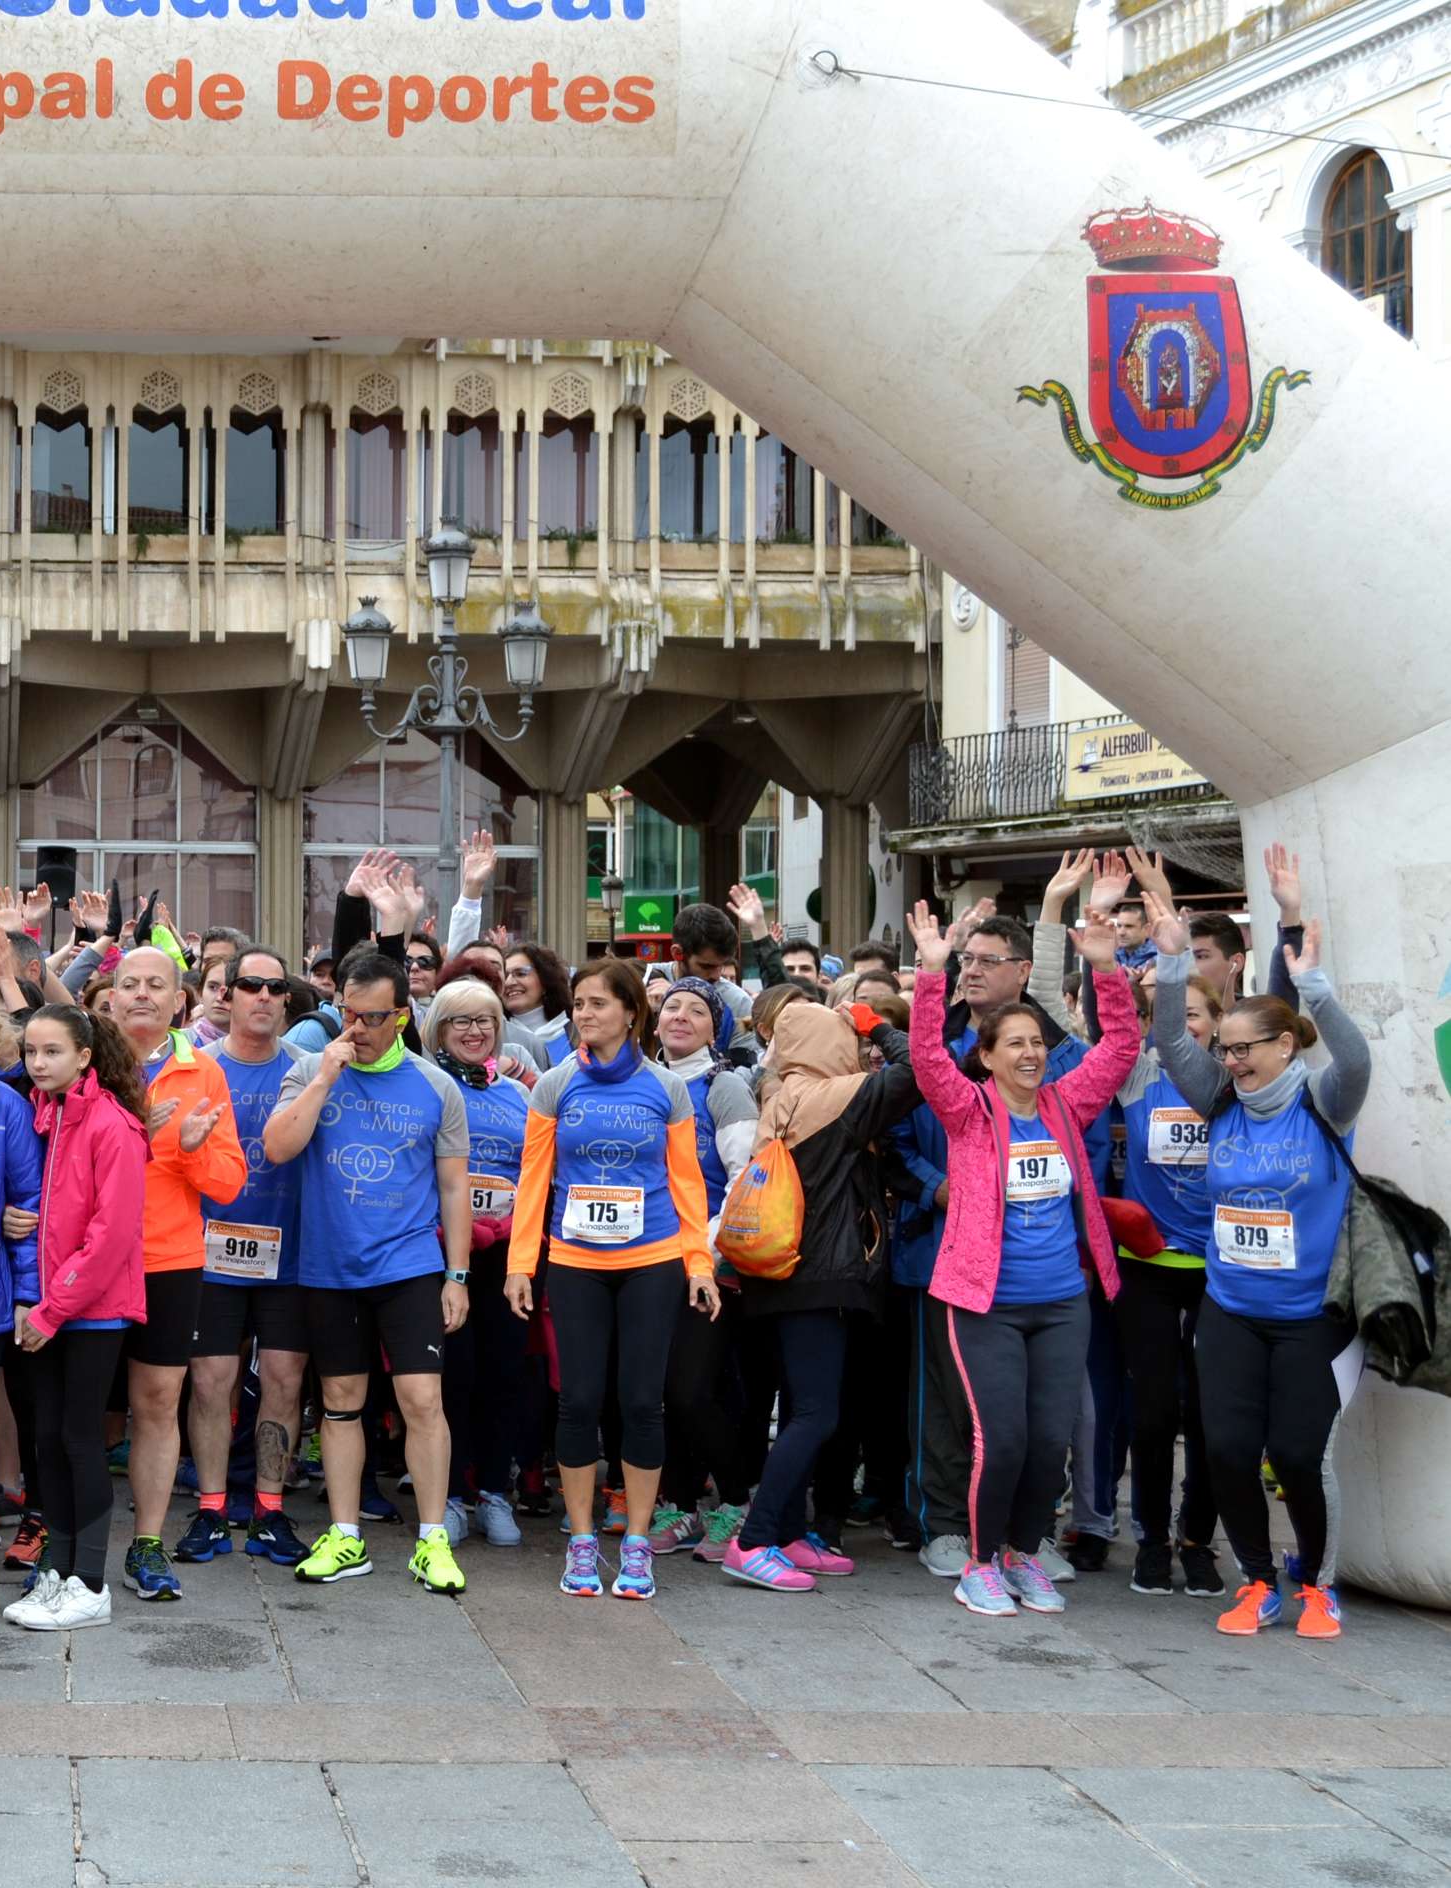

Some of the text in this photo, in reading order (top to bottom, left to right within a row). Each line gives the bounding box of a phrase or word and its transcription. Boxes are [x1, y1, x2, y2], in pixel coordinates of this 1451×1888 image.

[145, 57, 246, 121] de
[277, 59, 656, 139] Deportes
[230, 1088, 276, 1106] Carre
[340, 1091, 410, 1116] Carrera
[583, 1099, 648, 1117] Carrera
[371, 1113, 425, 1138] Mujer
[614, 1114, 659, 1135] Mujer
[1170, 1123, 1209, 1144] 936
[1016, 1157, 1049, 1179] 197
[1256, 1152, 1313, 1176] Mujer
[613, 1190, 638, 1201] mujer
[587, 1202, 618, 1223] 175
[1234, 1225, 1269, 1248] 879
[225, 1237, 258, 1258] 918
